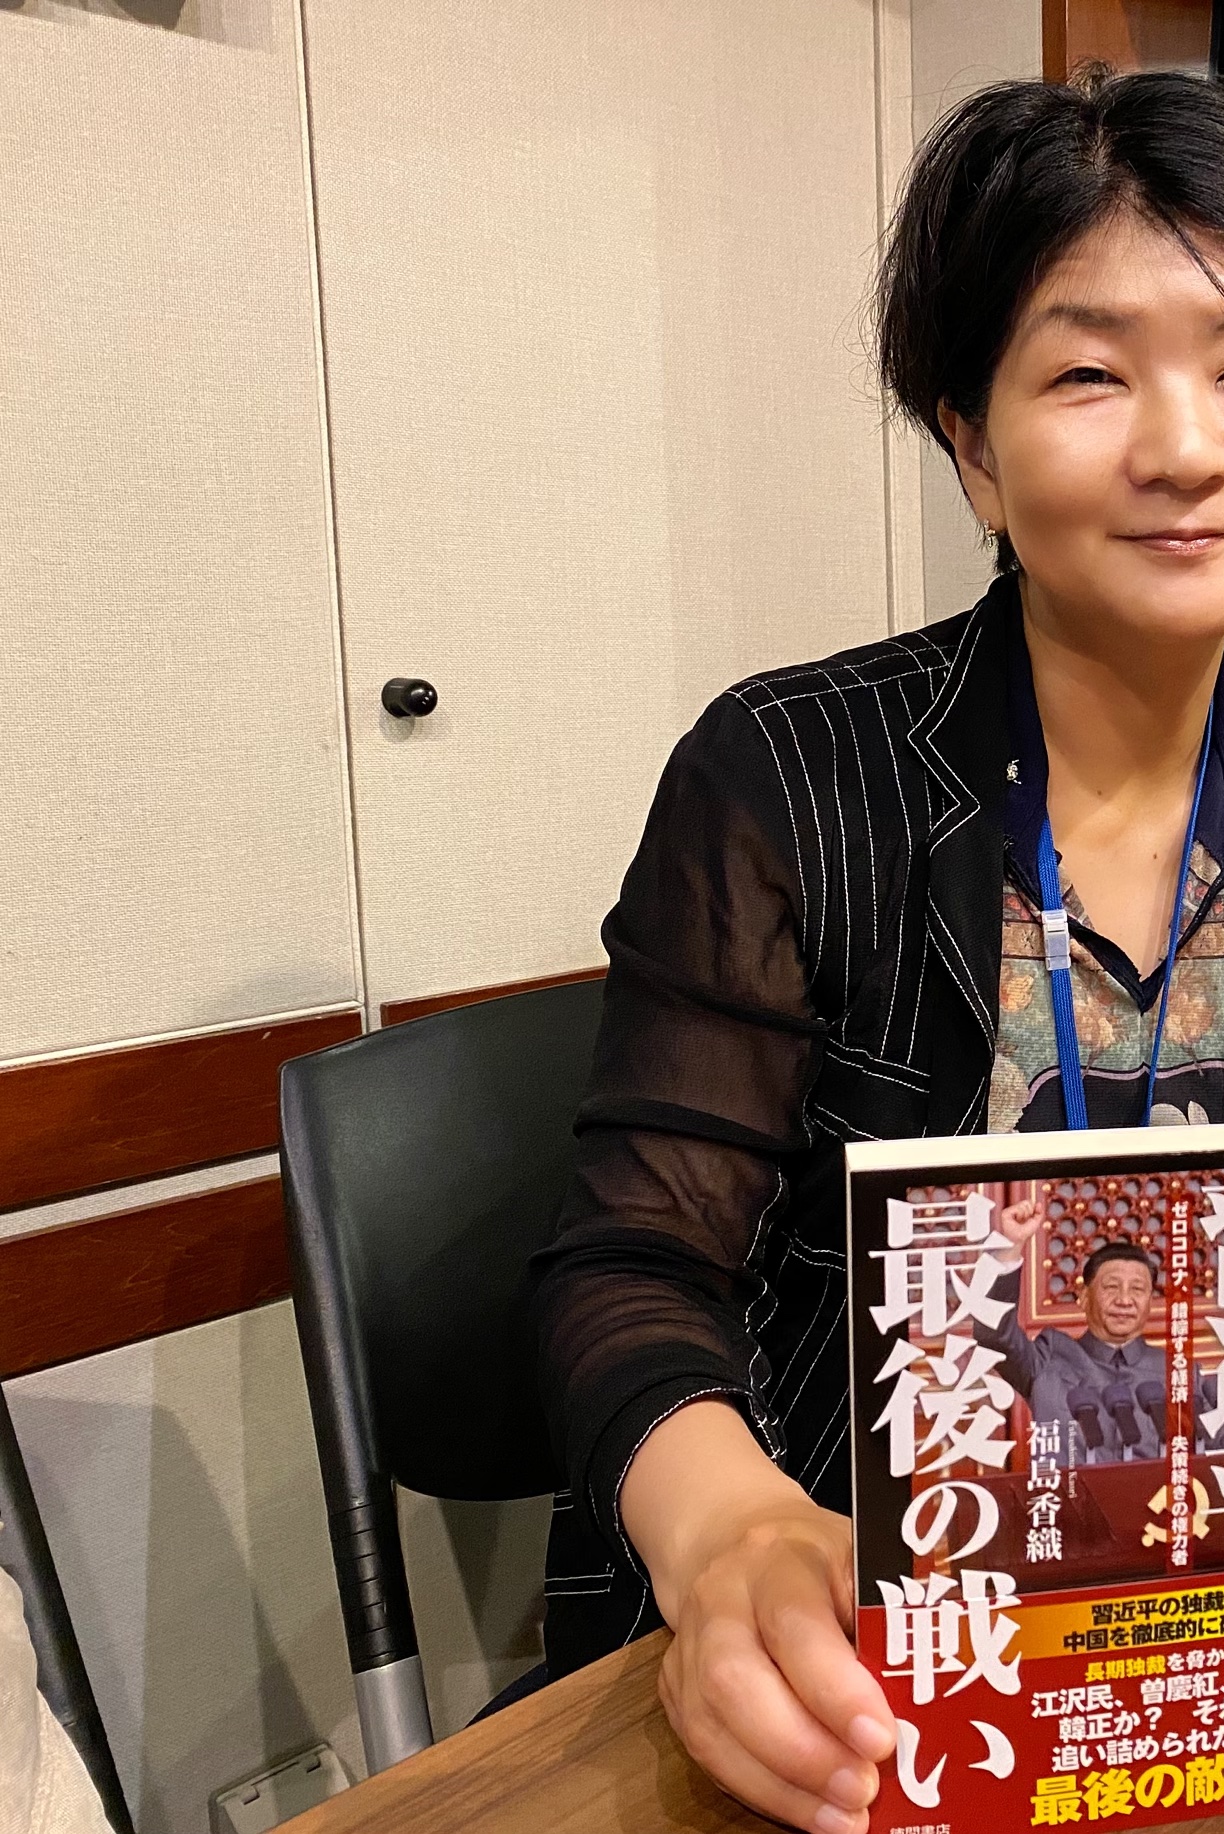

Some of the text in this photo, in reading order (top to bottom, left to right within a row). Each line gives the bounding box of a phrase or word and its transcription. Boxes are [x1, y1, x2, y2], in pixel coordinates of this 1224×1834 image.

[868, 1191, 1023, 1810] 最後の戦い
[1026, 1418, 1063, 1563] 福島香織
